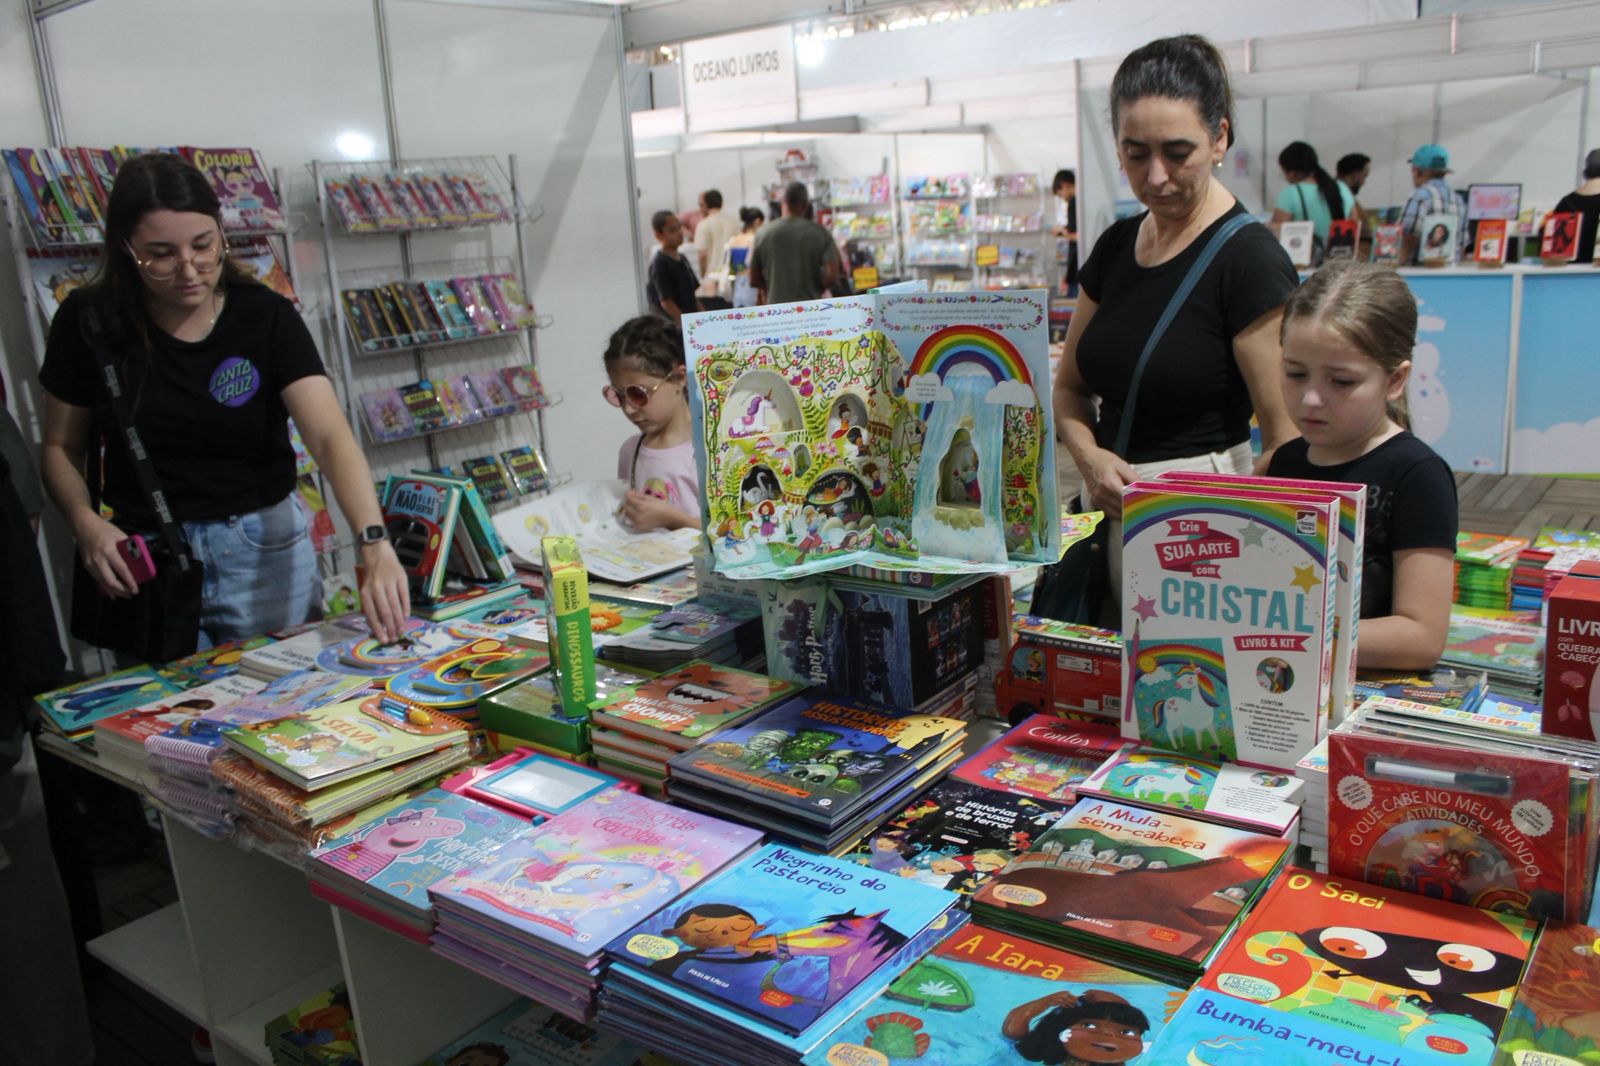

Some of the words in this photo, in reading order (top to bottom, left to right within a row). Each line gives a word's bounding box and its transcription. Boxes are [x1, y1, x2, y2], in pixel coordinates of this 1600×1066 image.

[693, 57, 737, 82] OCEANO
[740, 50, 779, 75] LIVROS
[208, 359, 251, 392] SANTA
[218, 375, 252, 403] CRUZ
[395, 489, 418, 512] NÃO
[1179, 521, 1200, 532] Crie
[1162, 543, 1195, 562] SUA
[1198, 542, 1233, 555] ARTE
[1196, 566, 1216, 575] com
[1161, 577, 1315, 634] CRISTAL
[1240, 638, 1267, 648] LIVRO
[1270, 638, 1278, 648] &
[1280, 638, 1297, 648] KIT
[566, 621, 586, 703] DINOSSAUROS
[808, 648, 828, 685] Harry
[321, 719, 378, 744] SELVA
[1028, 726, 1090, 747] Contos
[954, 805, 972, 814] de
[972, 810, 1017, 824] bruxas
[955, 812, 972, 821] de
[973, 817, 1014, 830] terror
[965, 801, 1019, 818] Histórias
[1087, 803, 1103, 816] A
[1108, 807, 1173, 828] Mula-
[1405, 807, 1486, 836] ATIVIDADES
[1078, 815, 1208, 850] sem-cabeça
[1349, 833, 1363, 847] O
[1358, 806, 1384, 834] QUE
[1381, 790, 1423, 813] CABE
[1425, 789, 1451, 805] NO
[1454, 796, 1494, 822] MEU
[1492, 817, 1542, 878] MUNDO
[752, 857, 848, 896] Pastoreio
[768, 848, 854, 882] Negrinho
[860, 877, 888, 892] do
[1287, 874, 1313, 890] O
[1319, 881, 1387, 910] Saci
[955, 934, 984, 955] A
[985, 941, 1065, 981] Iara
[1309, 1009, 1330, 1020] FOLHA
